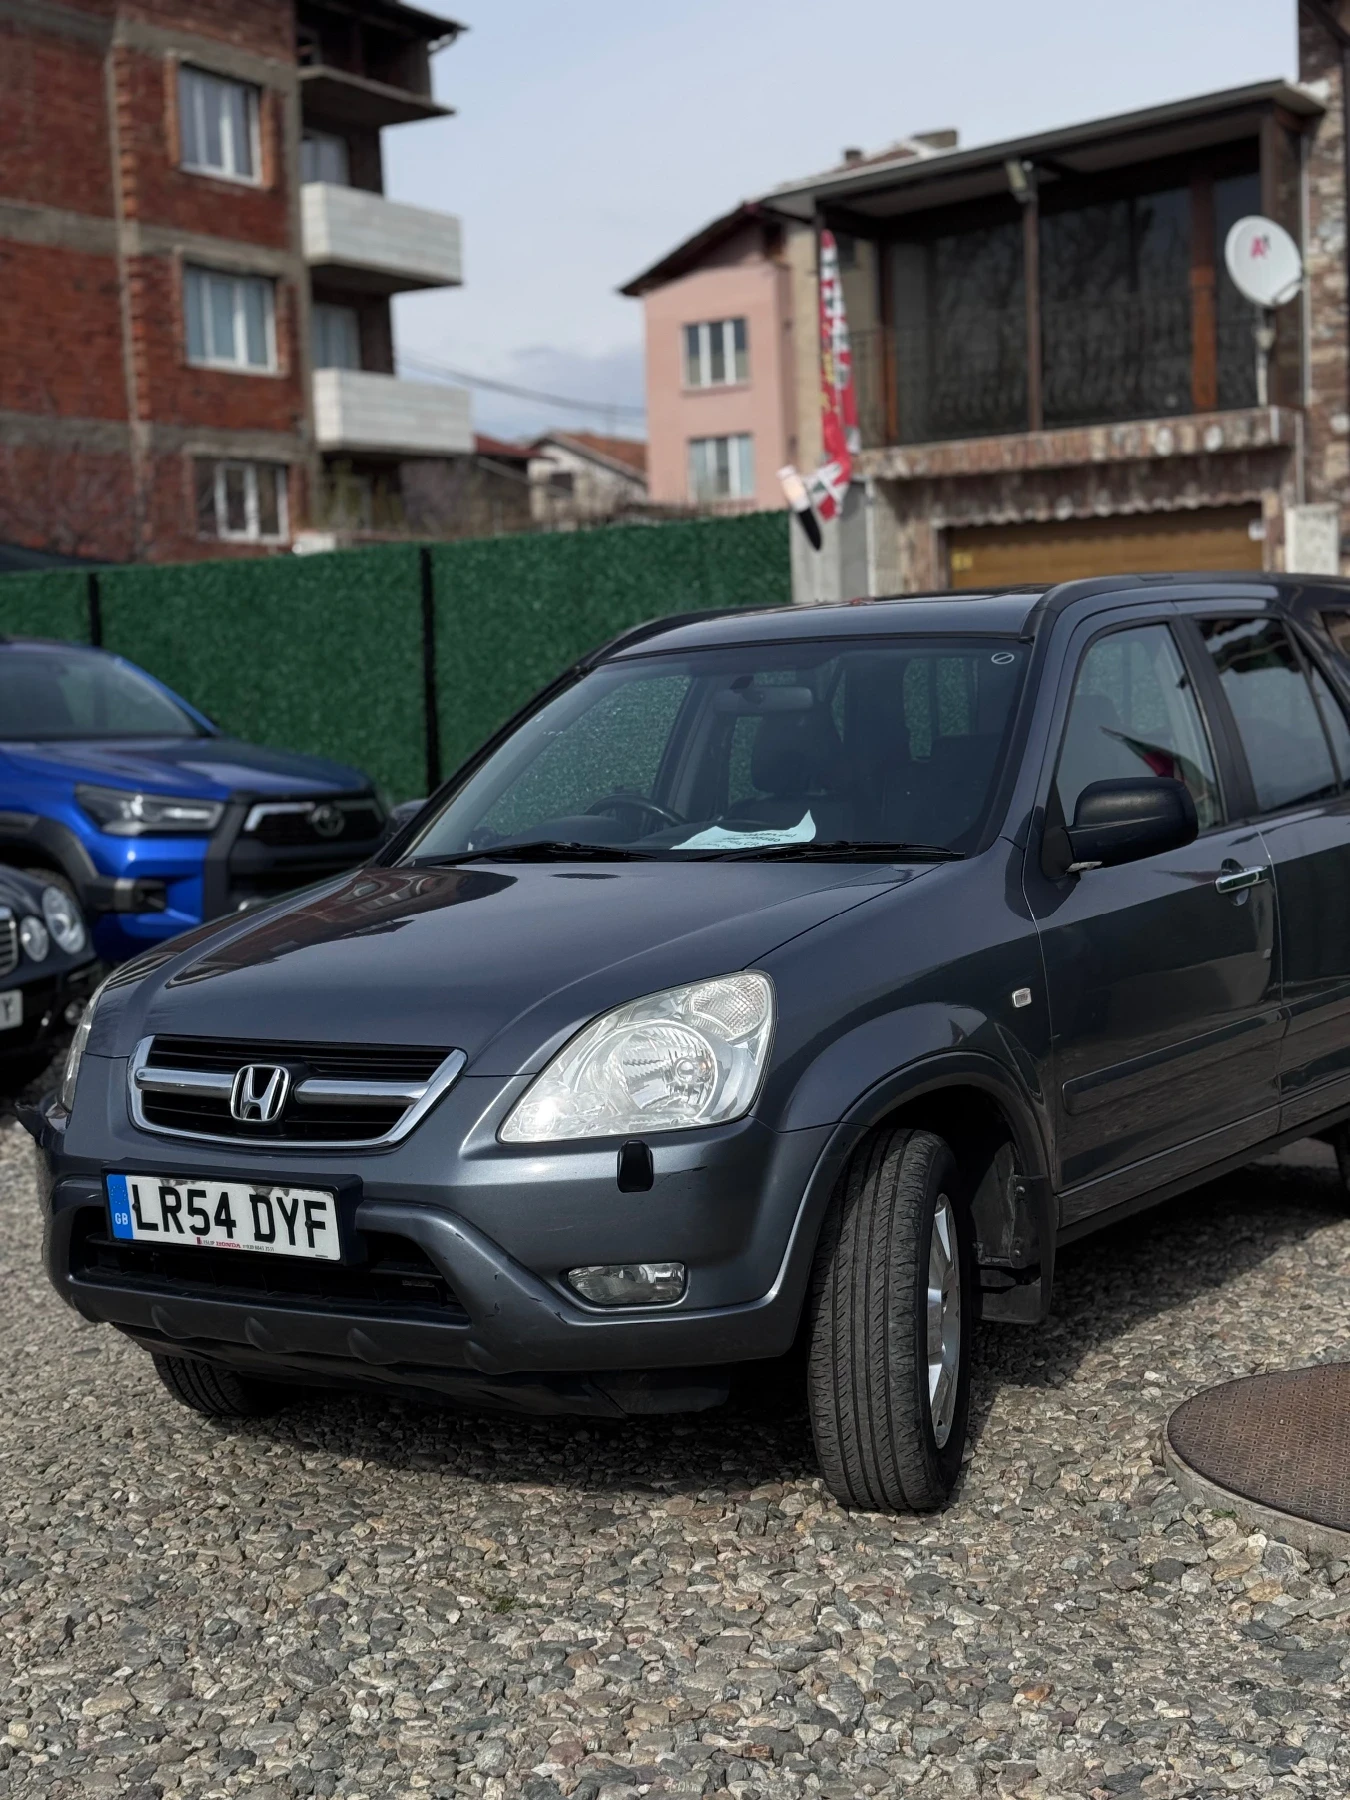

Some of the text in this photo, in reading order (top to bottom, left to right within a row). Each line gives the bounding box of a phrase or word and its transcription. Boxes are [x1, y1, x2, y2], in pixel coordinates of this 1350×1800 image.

[114, 1212, 129, 1225] GB
[131, 1184, 327, 1248] LR54 DYF
